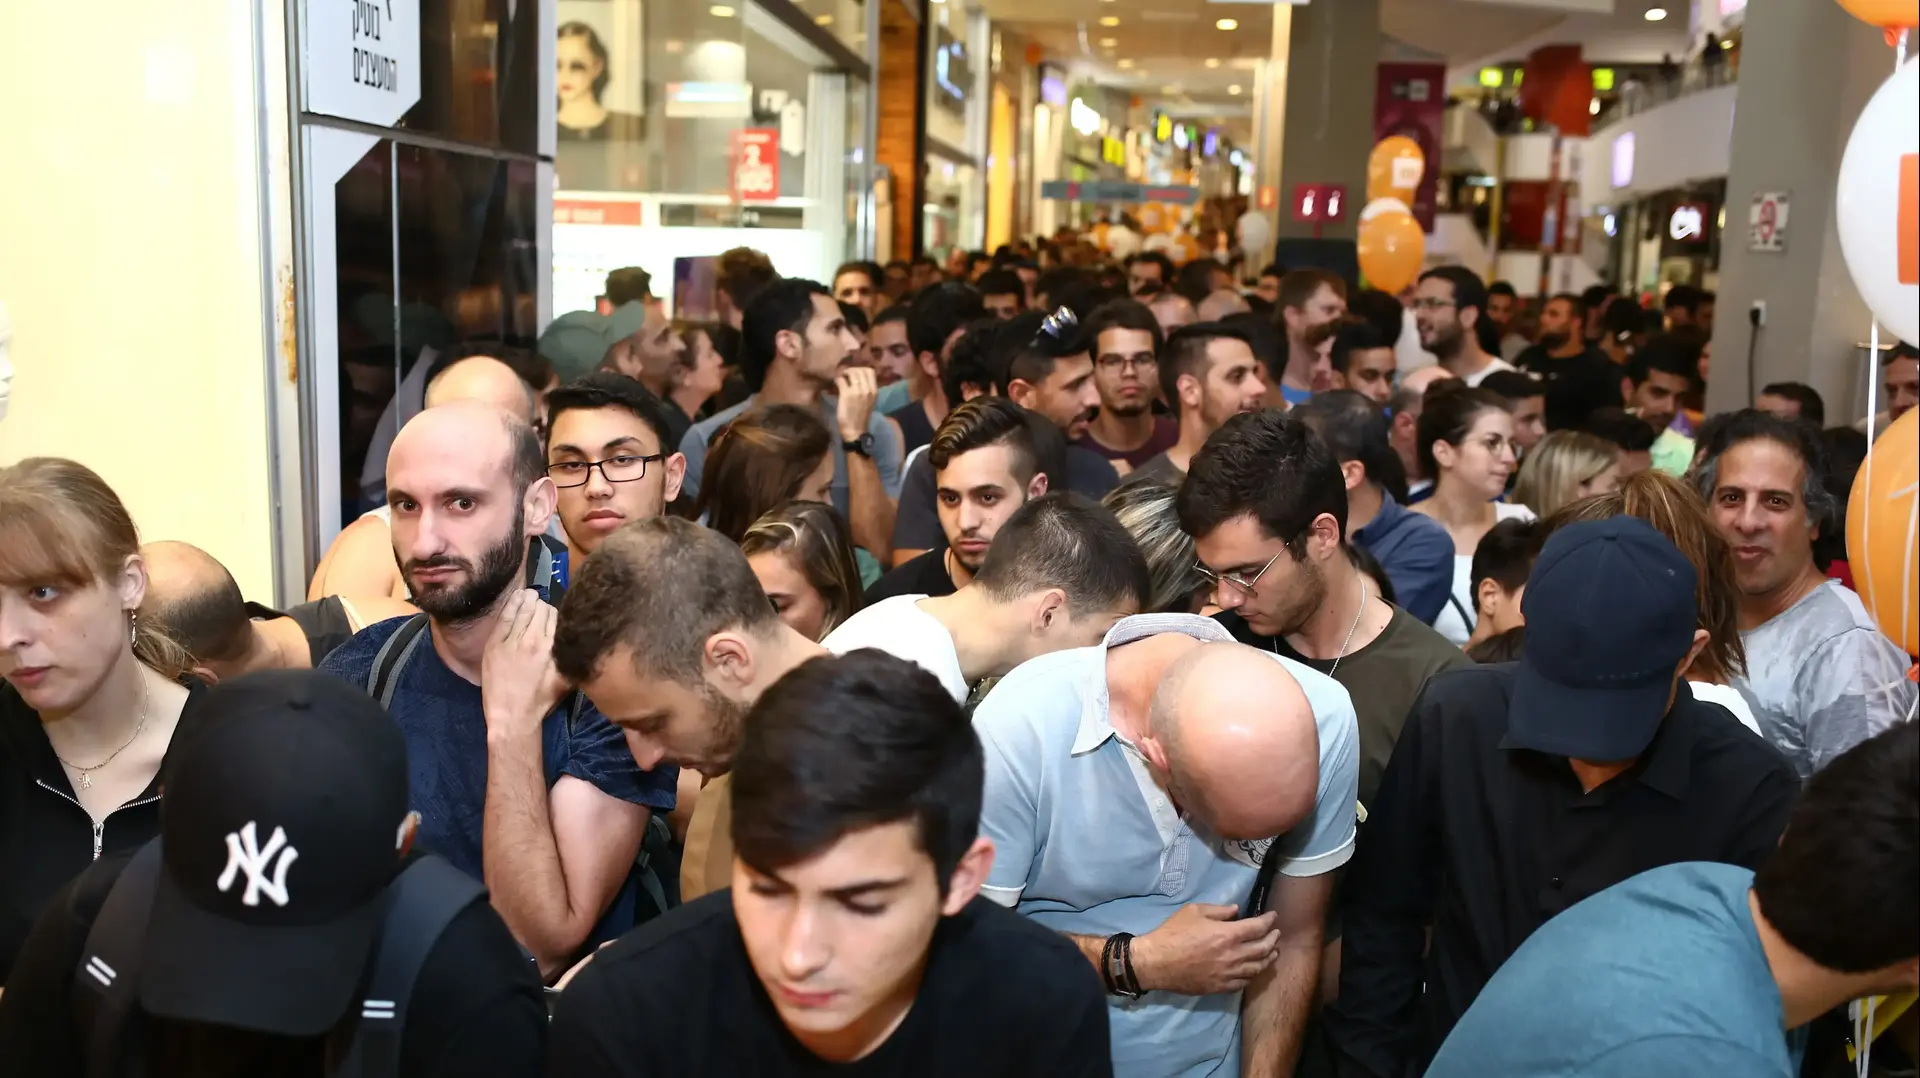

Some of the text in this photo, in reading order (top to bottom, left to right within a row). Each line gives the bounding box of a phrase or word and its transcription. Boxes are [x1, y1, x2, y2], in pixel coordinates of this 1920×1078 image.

[353, 0, 380, 41] בוטיק
[353, 47, 397, 93] המעצבים
[217, 820, 299, 907] NY
